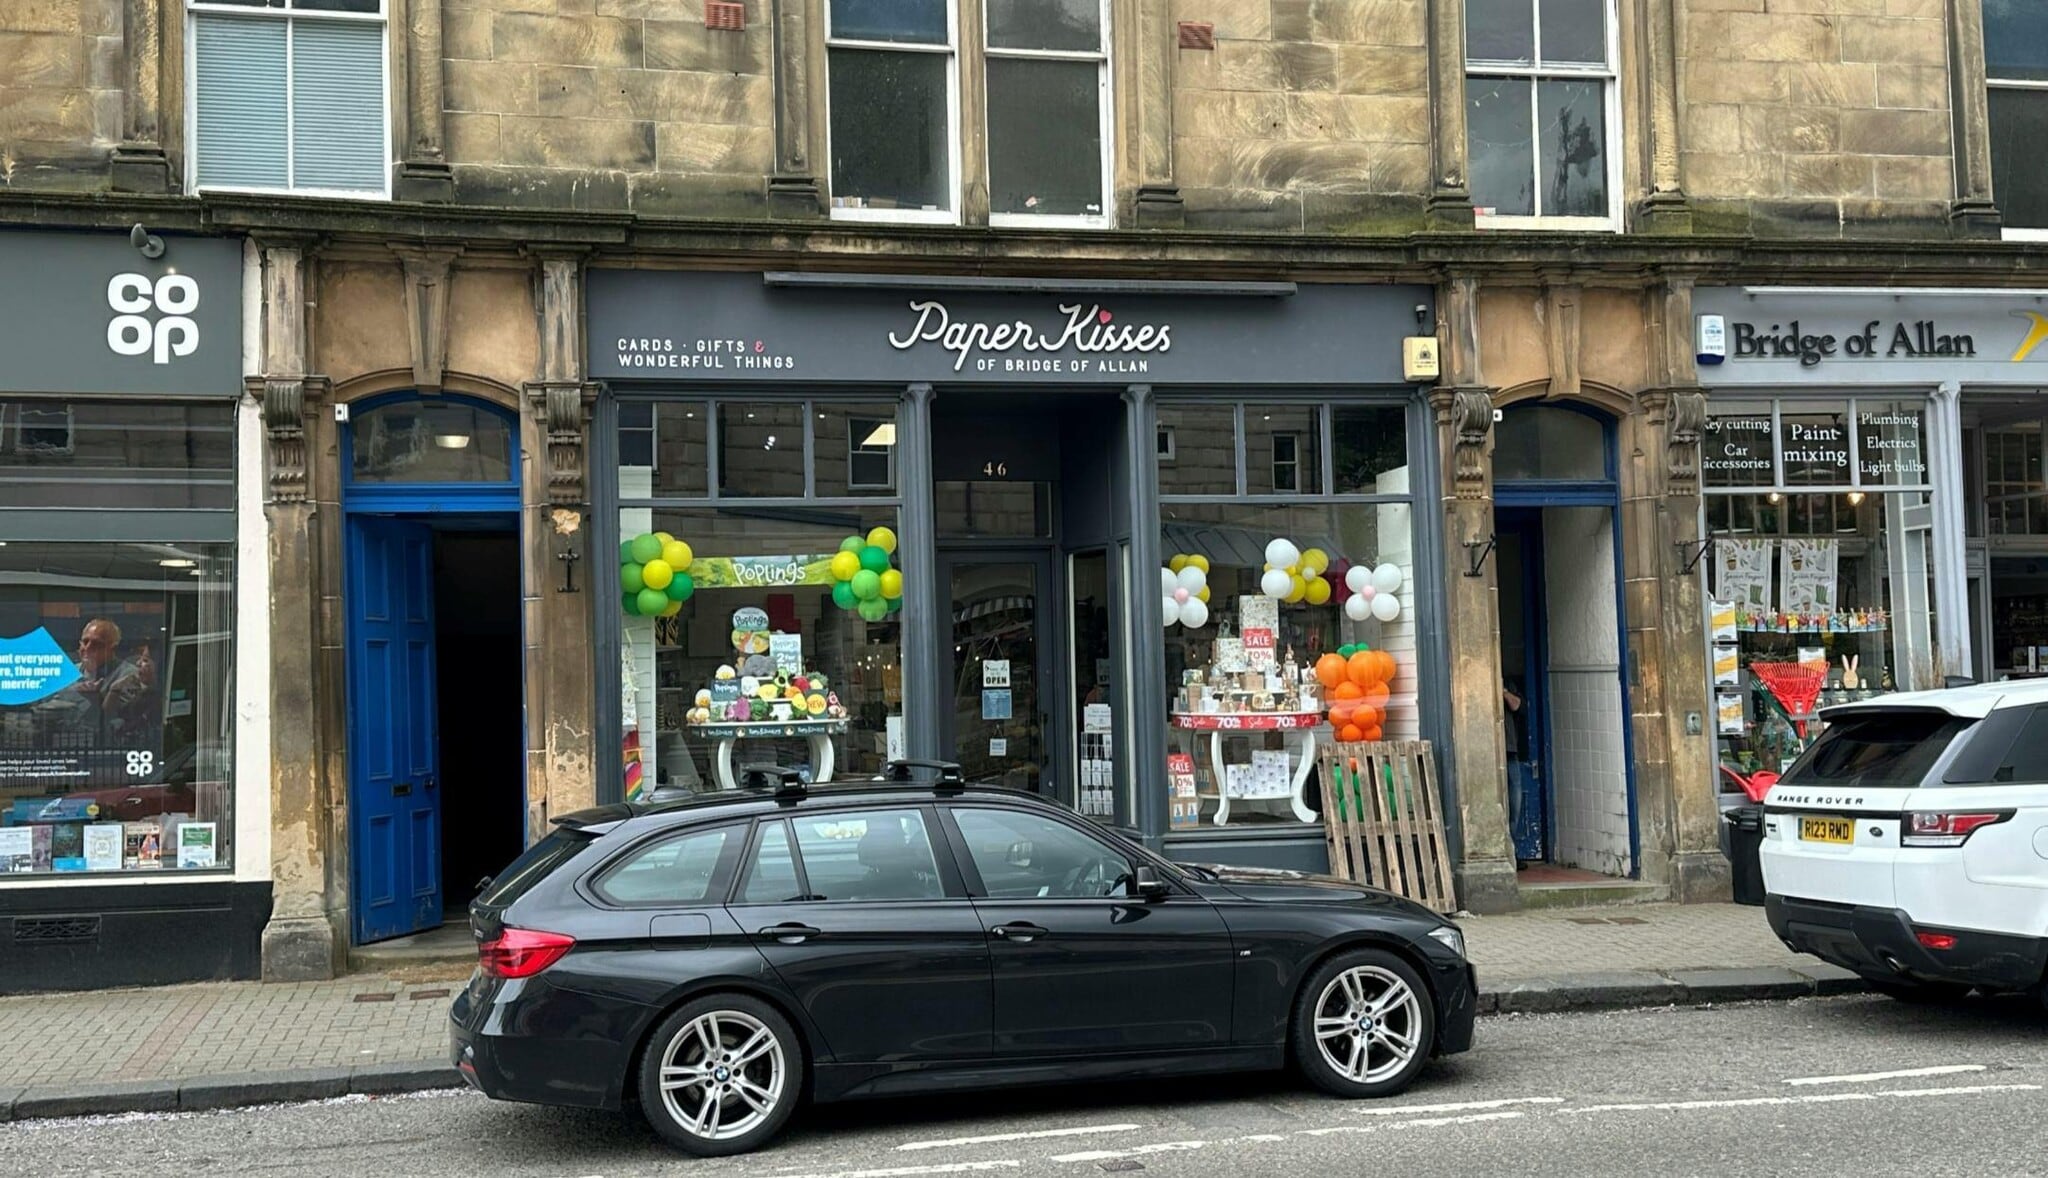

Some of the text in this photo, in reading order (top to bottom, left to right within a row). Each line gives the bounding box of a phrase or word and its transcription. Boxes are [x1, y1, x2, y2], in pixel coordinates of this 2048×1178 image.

[889, 300, 1171, 371] Paper Kisses
[617, 338, 765, 353] CARDS GIFTS &
[1733, 320, 1976, 367] Bridge of Allan
[618, 354, 795, 369] WONDERFUL THINGS
[976, 359, 1149, 373] OF BRIDGE OF ALLAN
[1726, 418, 1771, 433] cutting
[1861, 412, 1920, 429] Plumbing
[1867, 435, 1916, 449] Electrics
[1724, 443, 1749, 456] Car
[1784, 445, 1847, 467] mixing
[983, 461, 1007, 477] 46
[1703, 457, 1771, 469] accessories
[1860, 459, 1926, 477] Light bulbs
[1246, 635, 1271, 647] SALE
[14, 654, 63, 666] everyone
[776, 653, 785, 663] 2
[15, 665, 32, 676] the
[33, 667, 61, 676] more
[985, 676, 1007, 685] OPEN
[1168, 763, 1191, 772] SALE
[1777, 795, 1864, 806] RANGE ROVER
[1805, 820, 1849, 841] R123 RMD
